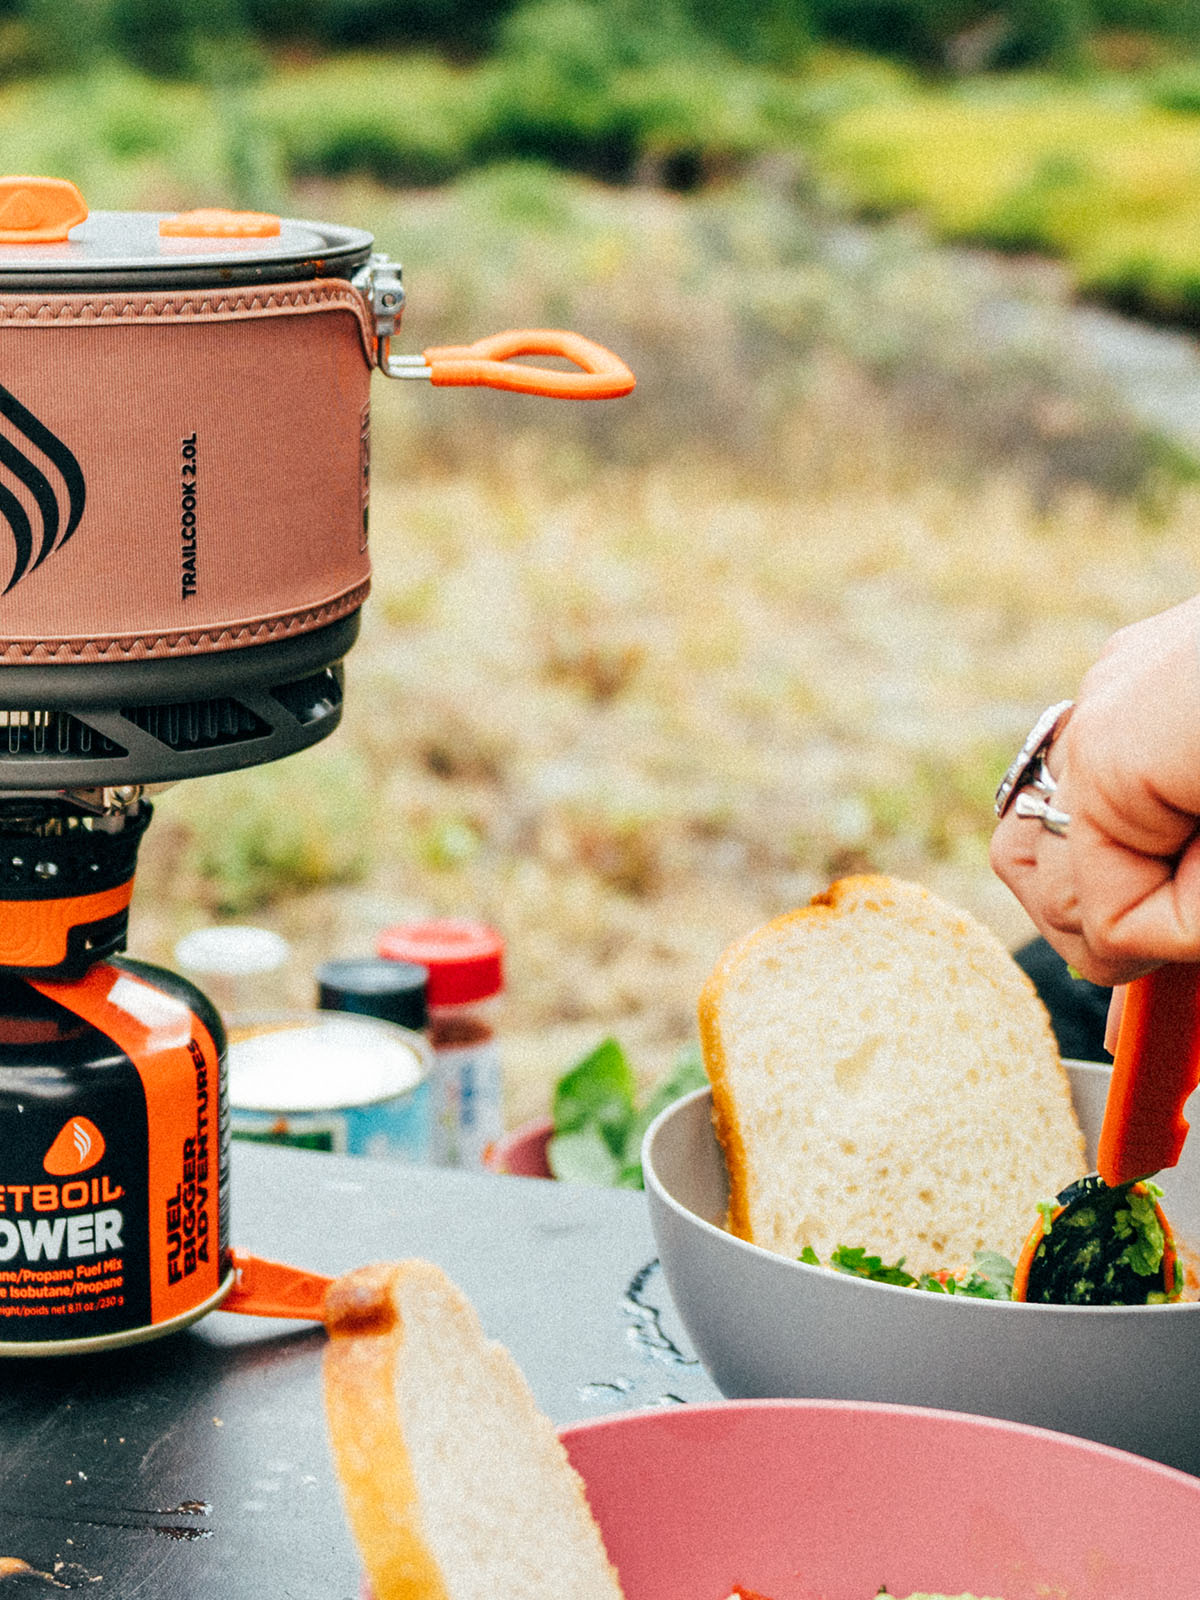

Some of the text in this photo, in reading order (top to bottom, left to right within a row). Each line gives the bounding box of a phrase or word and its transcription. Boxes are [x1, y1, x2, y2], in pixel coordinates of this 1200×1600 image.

[182, 433, 197, 600] TRAILCOOK 2.0L
[183, 1137, 197, 1276] BIGGER
[187, 1039, 209, 1263] ADVENTURES
[9, 1276, 123, 1298] Isobutane/Propane
[76, 1262, 102, 1278] Fuel
[103, 1257, 123, 1273] Mix
[167, 1183, 182, 1286] FUEL
